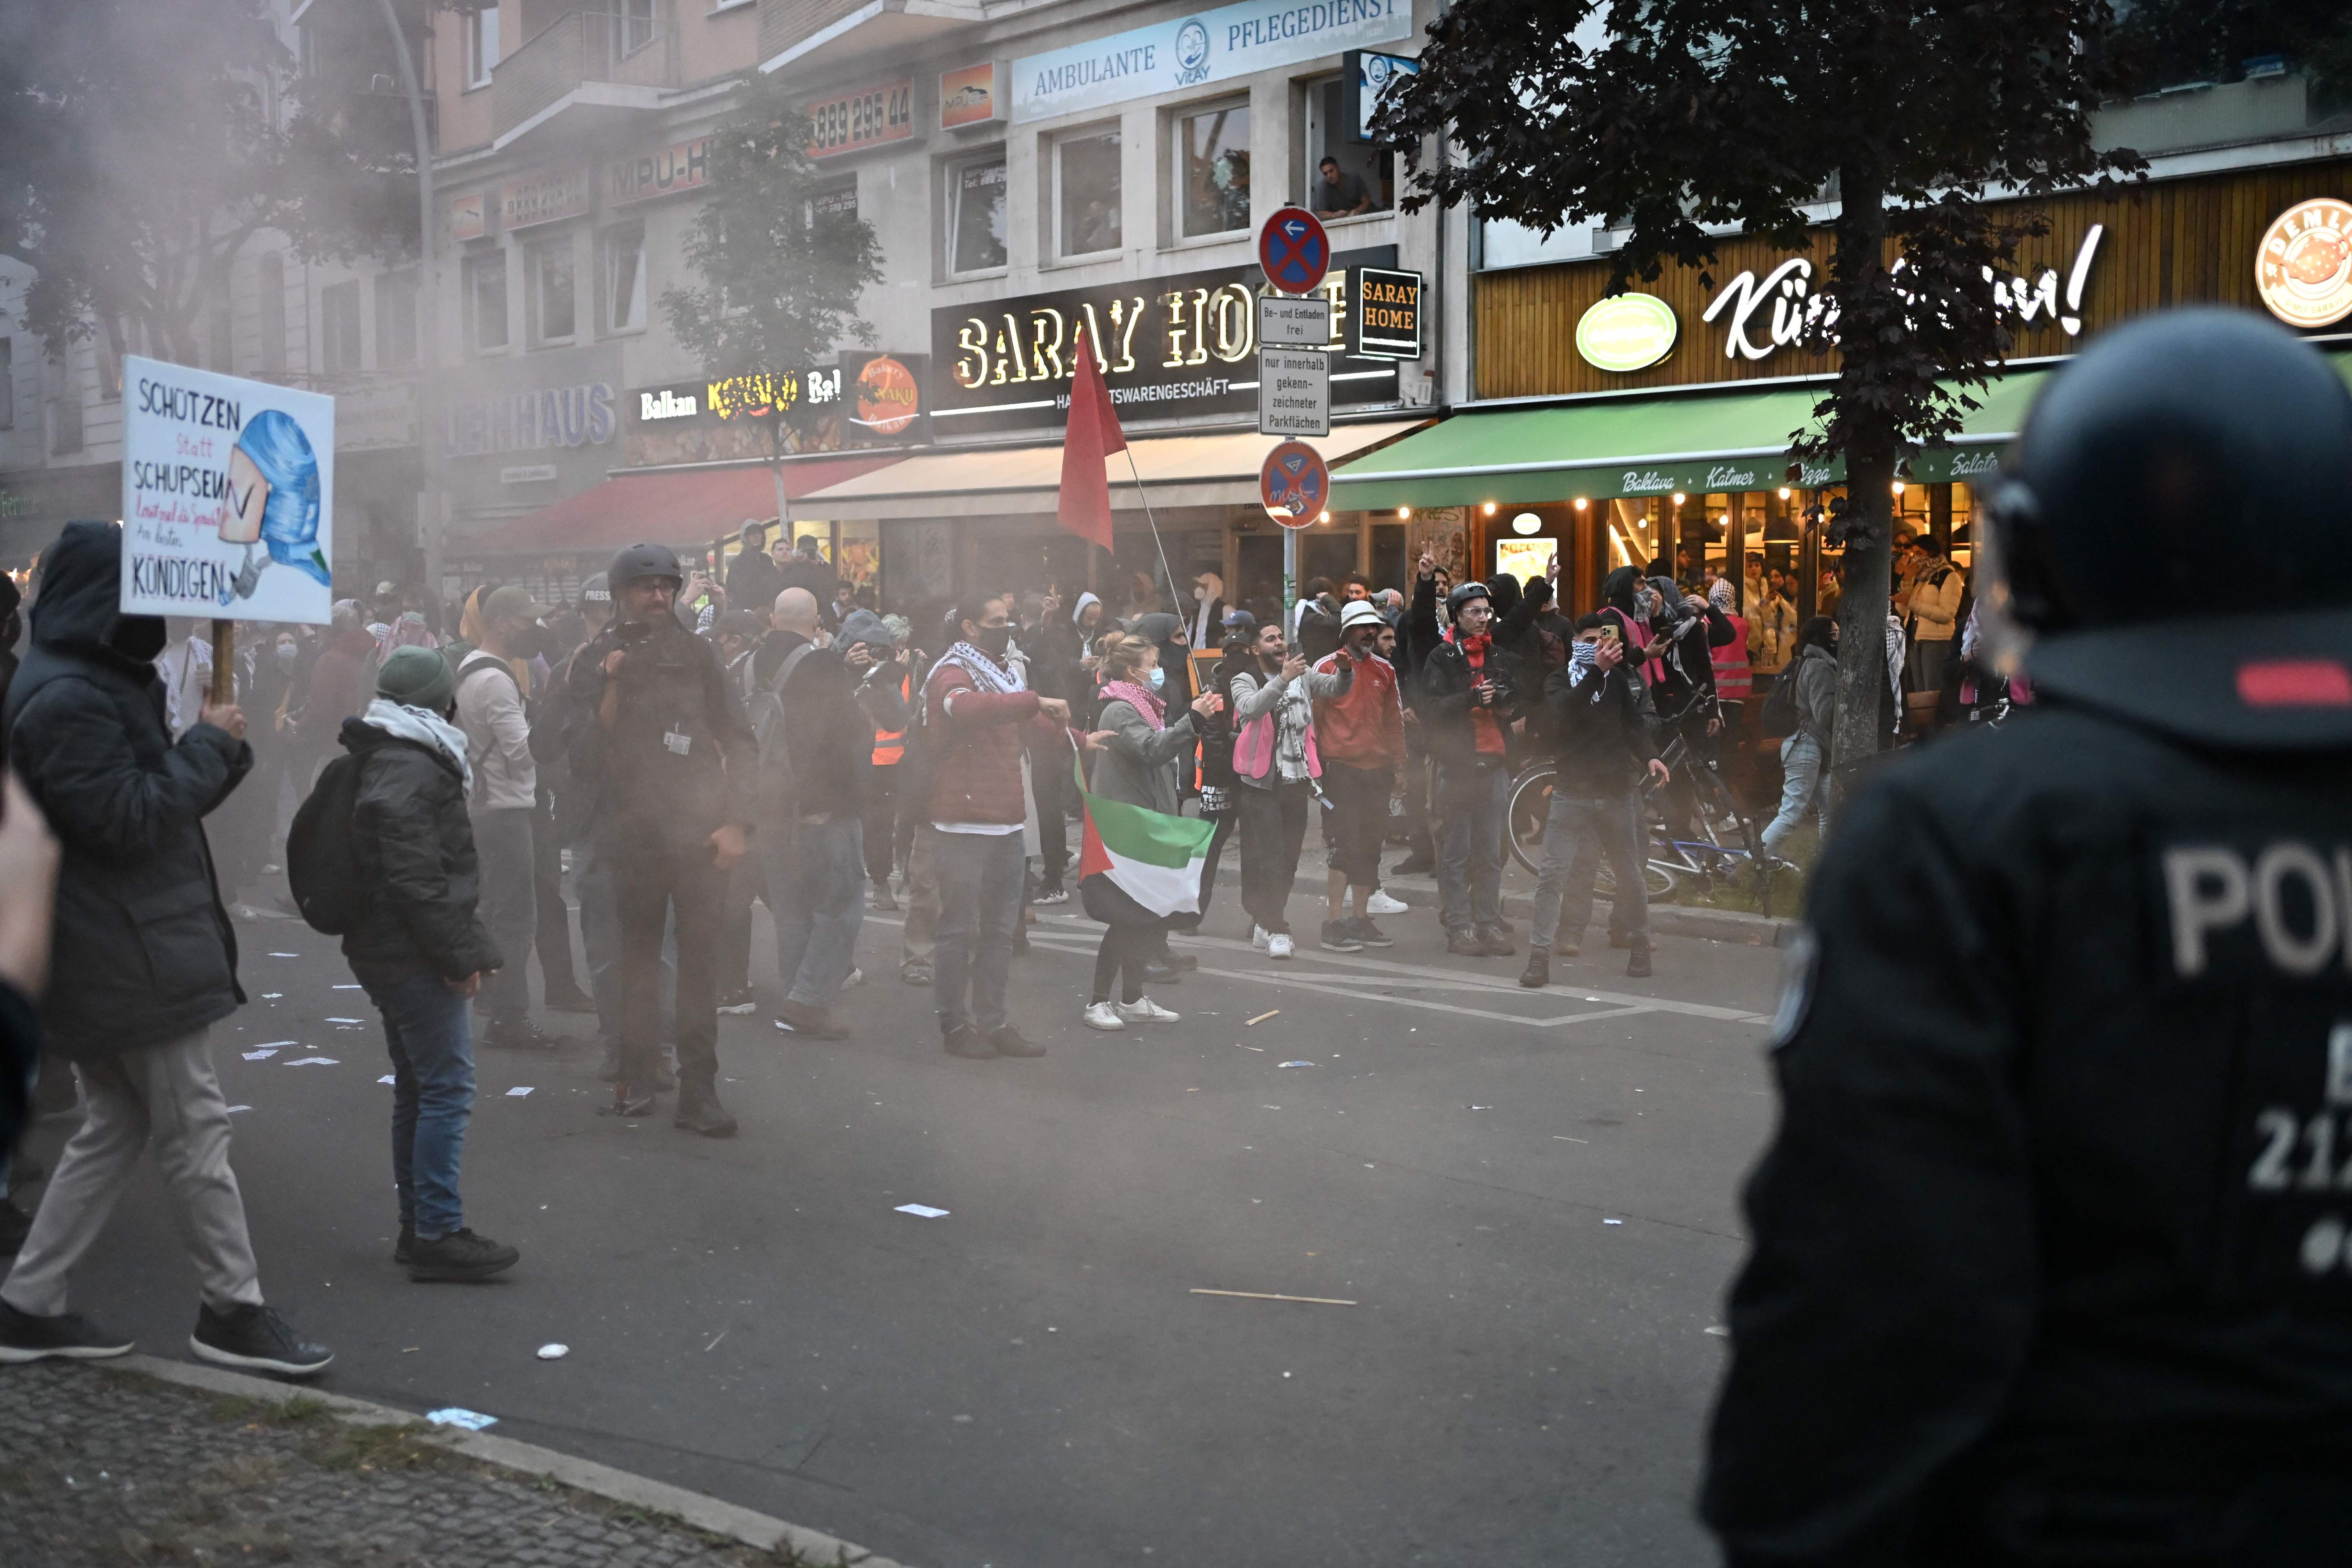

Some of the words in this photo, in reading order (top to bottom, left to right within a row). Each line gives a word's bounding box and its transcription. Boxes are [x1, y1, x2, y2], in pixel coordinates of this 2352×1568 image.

[1035, 44, 1156, 96] AMBULANTE
[818, 100, 847, 151] 889
[853, 92, 883, 143] 295
[889, 86, 909, 132] 44
[611, 138, 714, 196] MPU-H
[2268, 208, 2352, 256] DEMLI
[1363, 281, 1417, 305] SARAY
[1264, 307, 1277, 318] Be-
[1280, 308, 1292, 319] und
[1295, 309, 1325, 320] Entladen
[1364, 307, 1414, 330] HOME
[959, 296, 1145, 388] SARAY
[1163, 281, 1347, 368] HOE
[1287, 324, 1303, 335] frei
[1265, 358, 1279, 369] nur
[1284, 356, 1325, 371] innerhalb
[1056, 377, 1229, 409] HATSWARENGESCHÄFT
[1277, 376, 1313, 391] gekenn-
[641, 390, 697, 420] Balkan
[860, 388, 913, 407] NAKU
[1272, 396, 1317, 409] zeichneter
[1269, 414, 1320, 429] Parkflächen
[177, 432, 212, 457] Statt
[1622, 471, 1675, 494] Baklava
[1706, 466, 1755, 488] Katmer
[1950, 452, 1998, 476] Salate
[678, 555, 695, 566] lkan
[585, 590, 611, 601] PRESS
[1201, 785, 1230, 794] FUCK
[1203, 794, 1225, 802] THE
